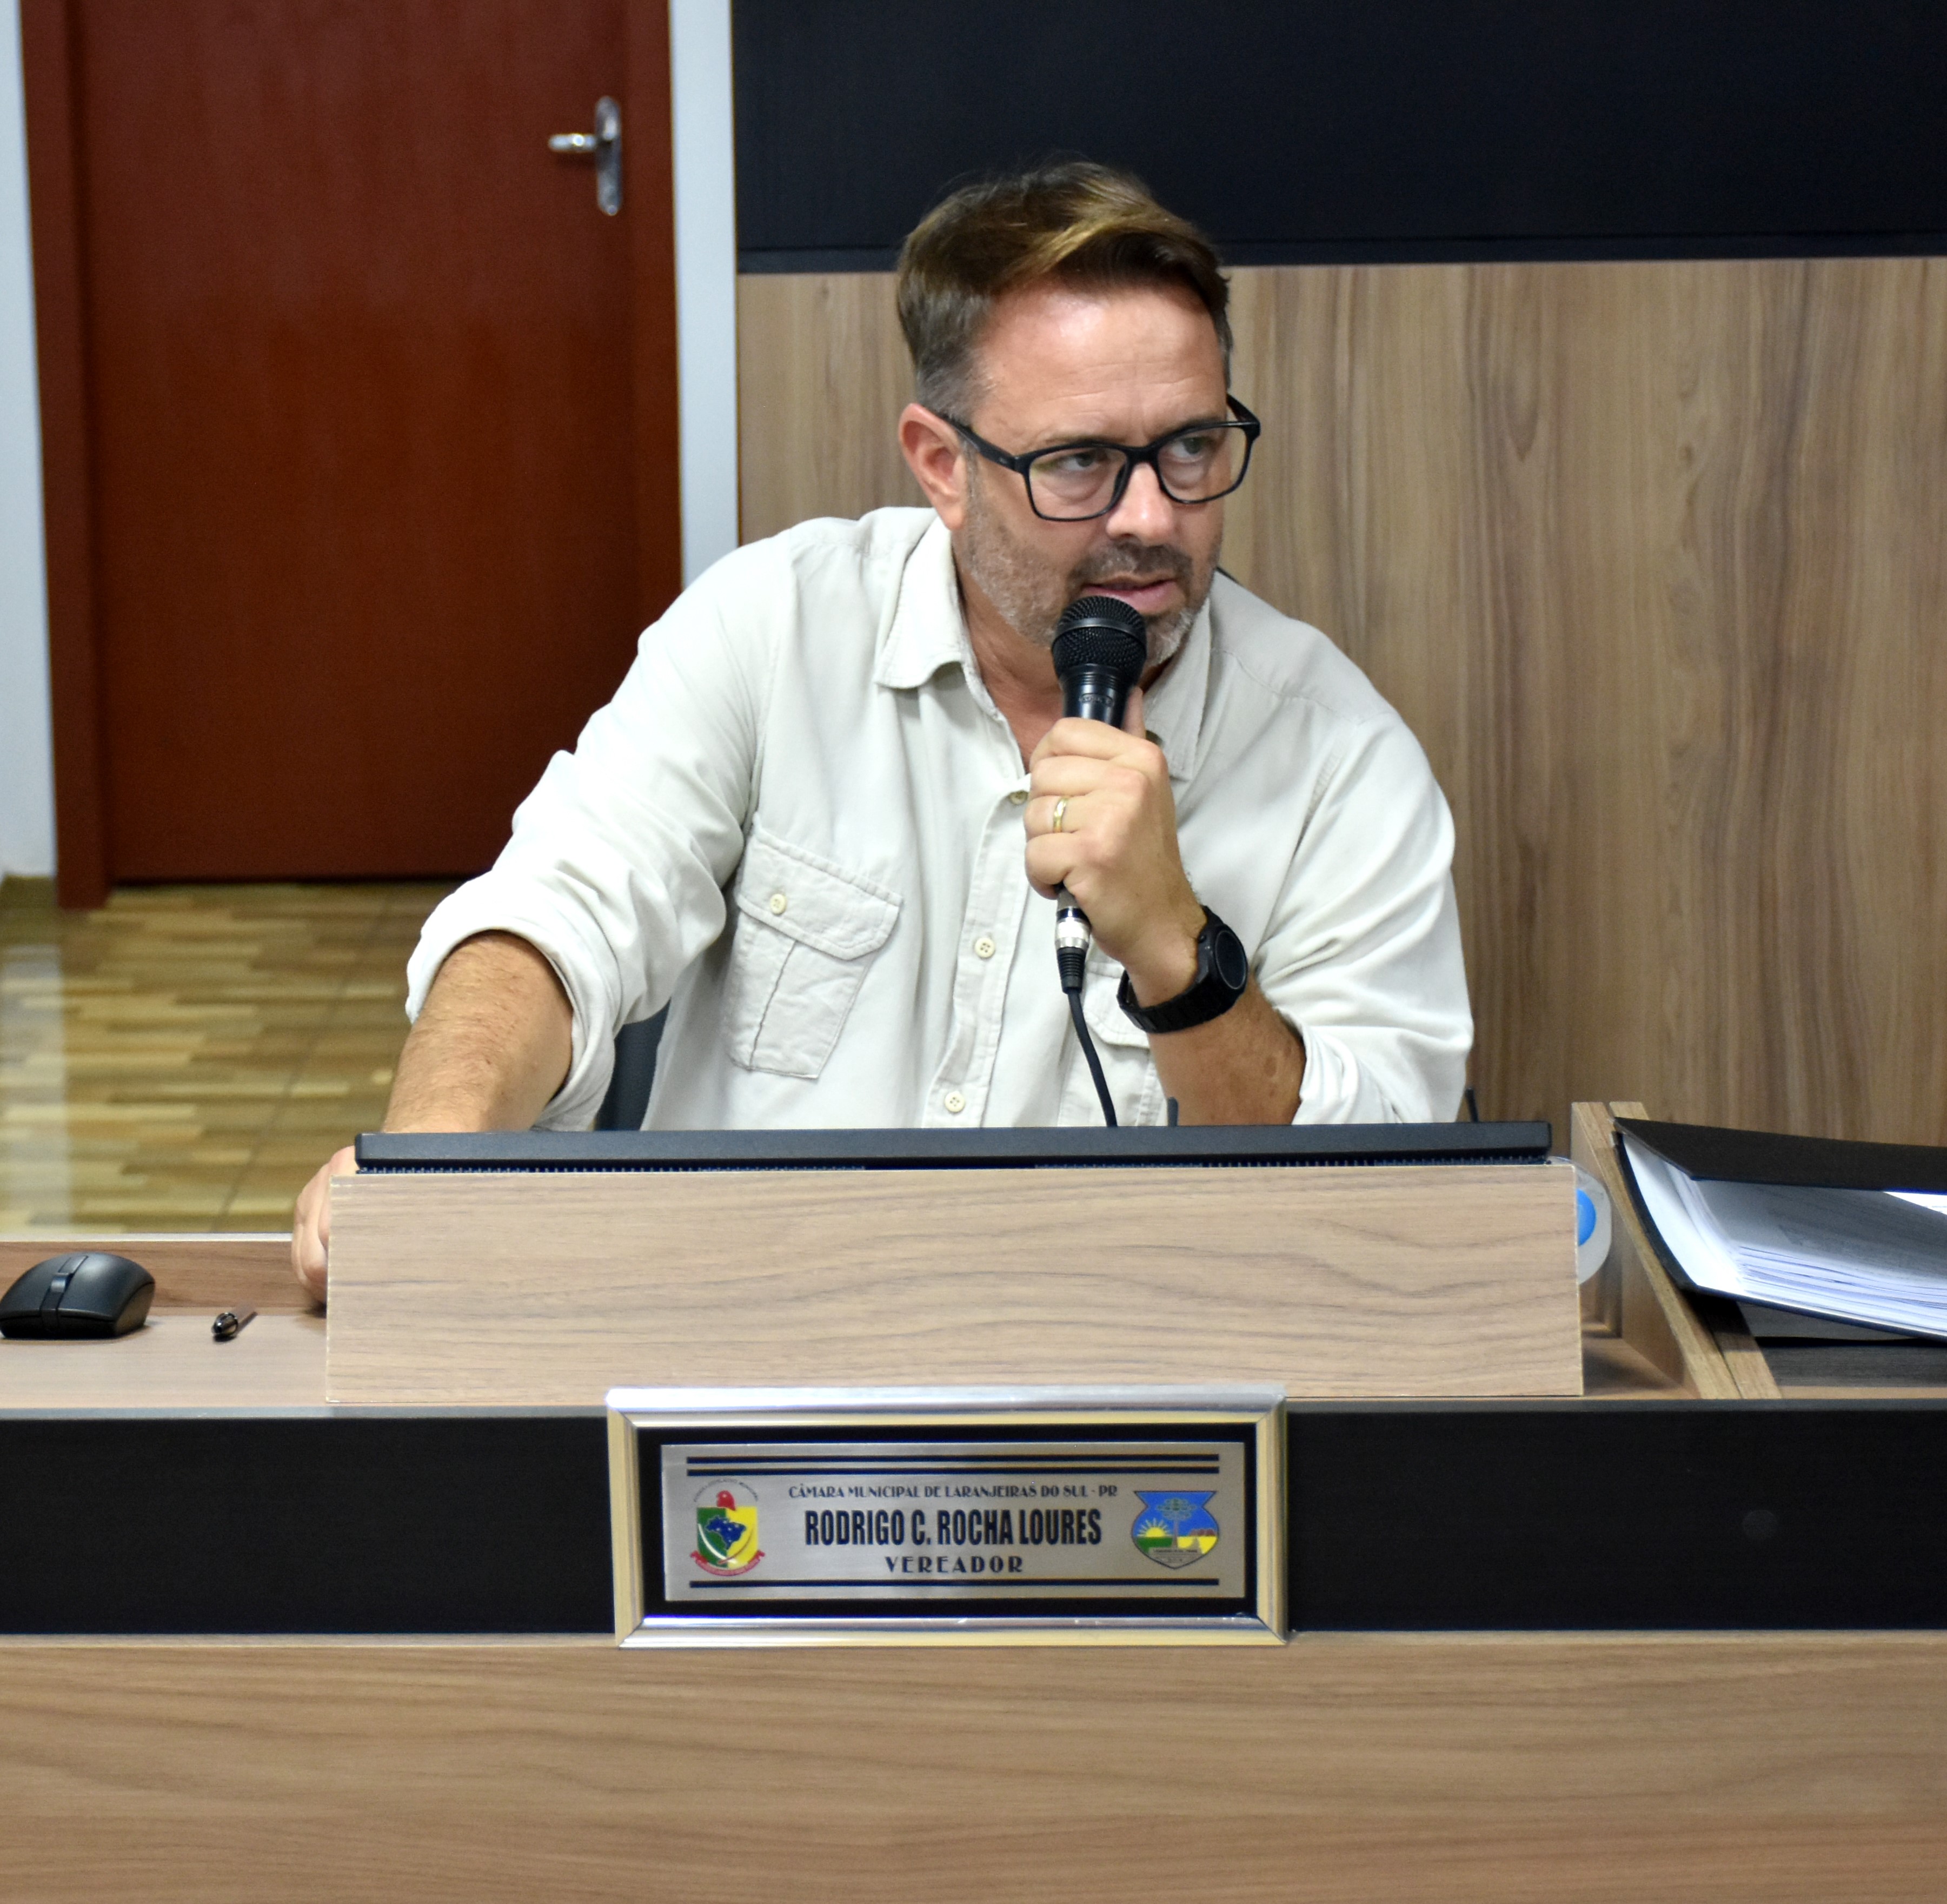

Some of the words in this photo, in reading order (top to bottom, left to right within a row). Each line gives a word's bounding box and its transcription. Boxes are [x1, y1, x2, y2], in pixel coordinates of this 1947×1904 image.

[788, 1483, 844, 1498] CÂMARA
[848, 1485, 921, 1497] MUNICIPAL
[925, 1486, 941, 1497] DE
[945, 1485, 1037, 1497] LARANJEIRAS
[1041, 1485, 1060, 1497] DO
[1064, 1485, 1087, 1497] SUL
[1099, 1485, 1118, 1497] PR
[805, 1509, 905, 1545] RODRIGO
[911, 1509, 931, 1545] C.
[938, 1509, 1014, 1545] ROCHA
[1019, 1508, 1102, 1545] LOURES
[885, 1555, 1024, 1574] VEREADOR
